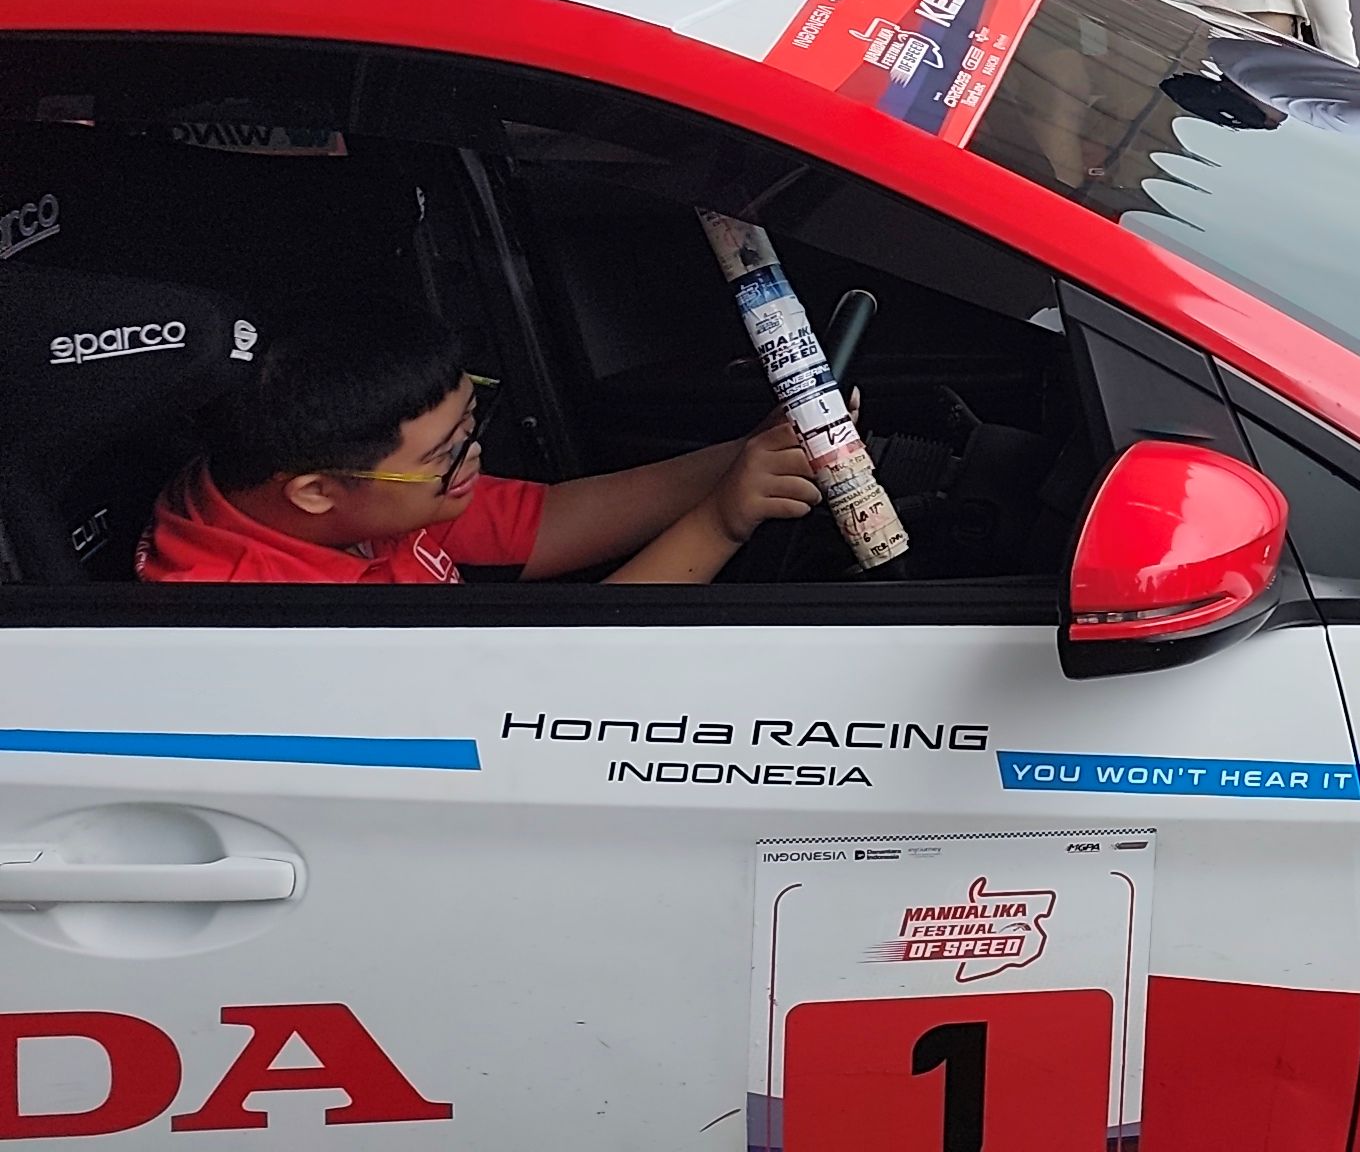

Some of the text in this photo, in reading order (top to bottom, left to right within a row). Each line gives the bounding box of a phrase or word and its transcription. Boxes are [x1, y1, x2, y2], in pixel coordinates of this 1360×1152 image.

[50, 321, 187, 364] sparco
[771, 345, 818, 373] SPEED
[501, 711, 990, 751] Honda RACING
[608, 759, 873, 788] INDONESIA
[1011, 761, 1084, 784] YOU
[1097, 765, 1207, 788] WON'T
[1220, 768, 1310, 790] HEAR
[1322, 771, 1354, 792] IT
[763, 851, 847, 863] INDONESIA
[900, 903, 1028, 926] MANDALIKA
[911, 922, 998, 938] FESTIVAL
[908, 938, 1023, 959] OF SPEED
[911, 1021, 989, 1152] 1
